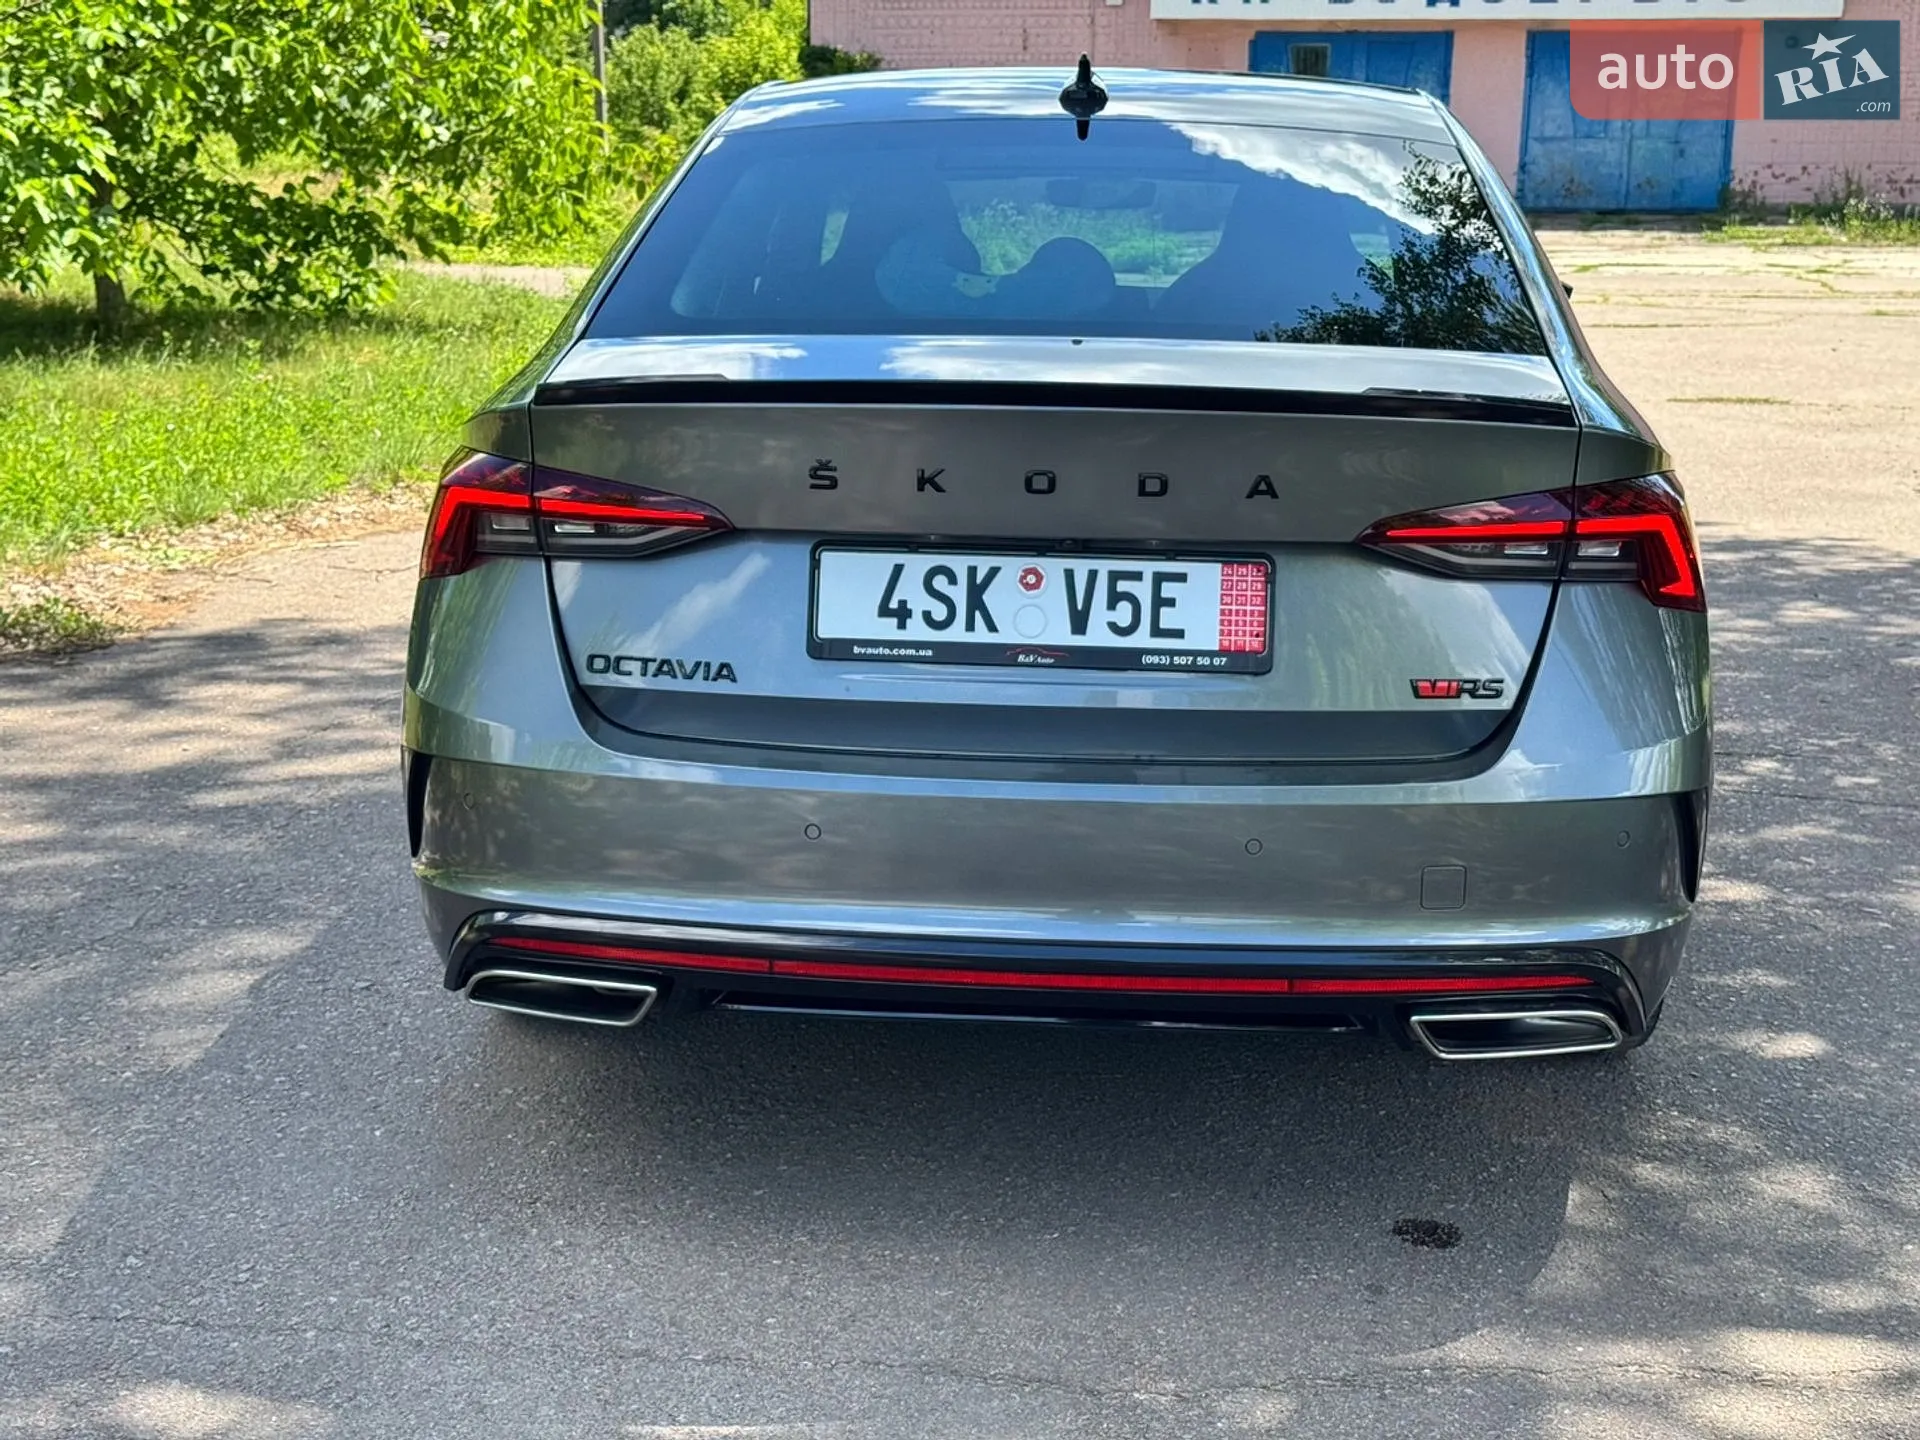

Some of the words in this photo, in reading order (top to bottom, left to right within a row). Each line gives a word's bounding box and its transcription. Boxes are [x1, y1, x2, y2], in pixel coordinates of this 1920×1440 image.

[808, 458, 1280, 500] ŠKODA
[877, 562, 1003, 633] 4SK
[1063, 567, 1188, 640] V5E
[853, 645, 933, 657] bvauto.com.ua
[1141, 654, 1171, 666] (093)
[1173, 656, 1193, 665] 507
[1196, 656, 1210, 666] 50
[1212, 657, 1227, 666] 07
[586, 653, 738, 684] OCTAVIA
